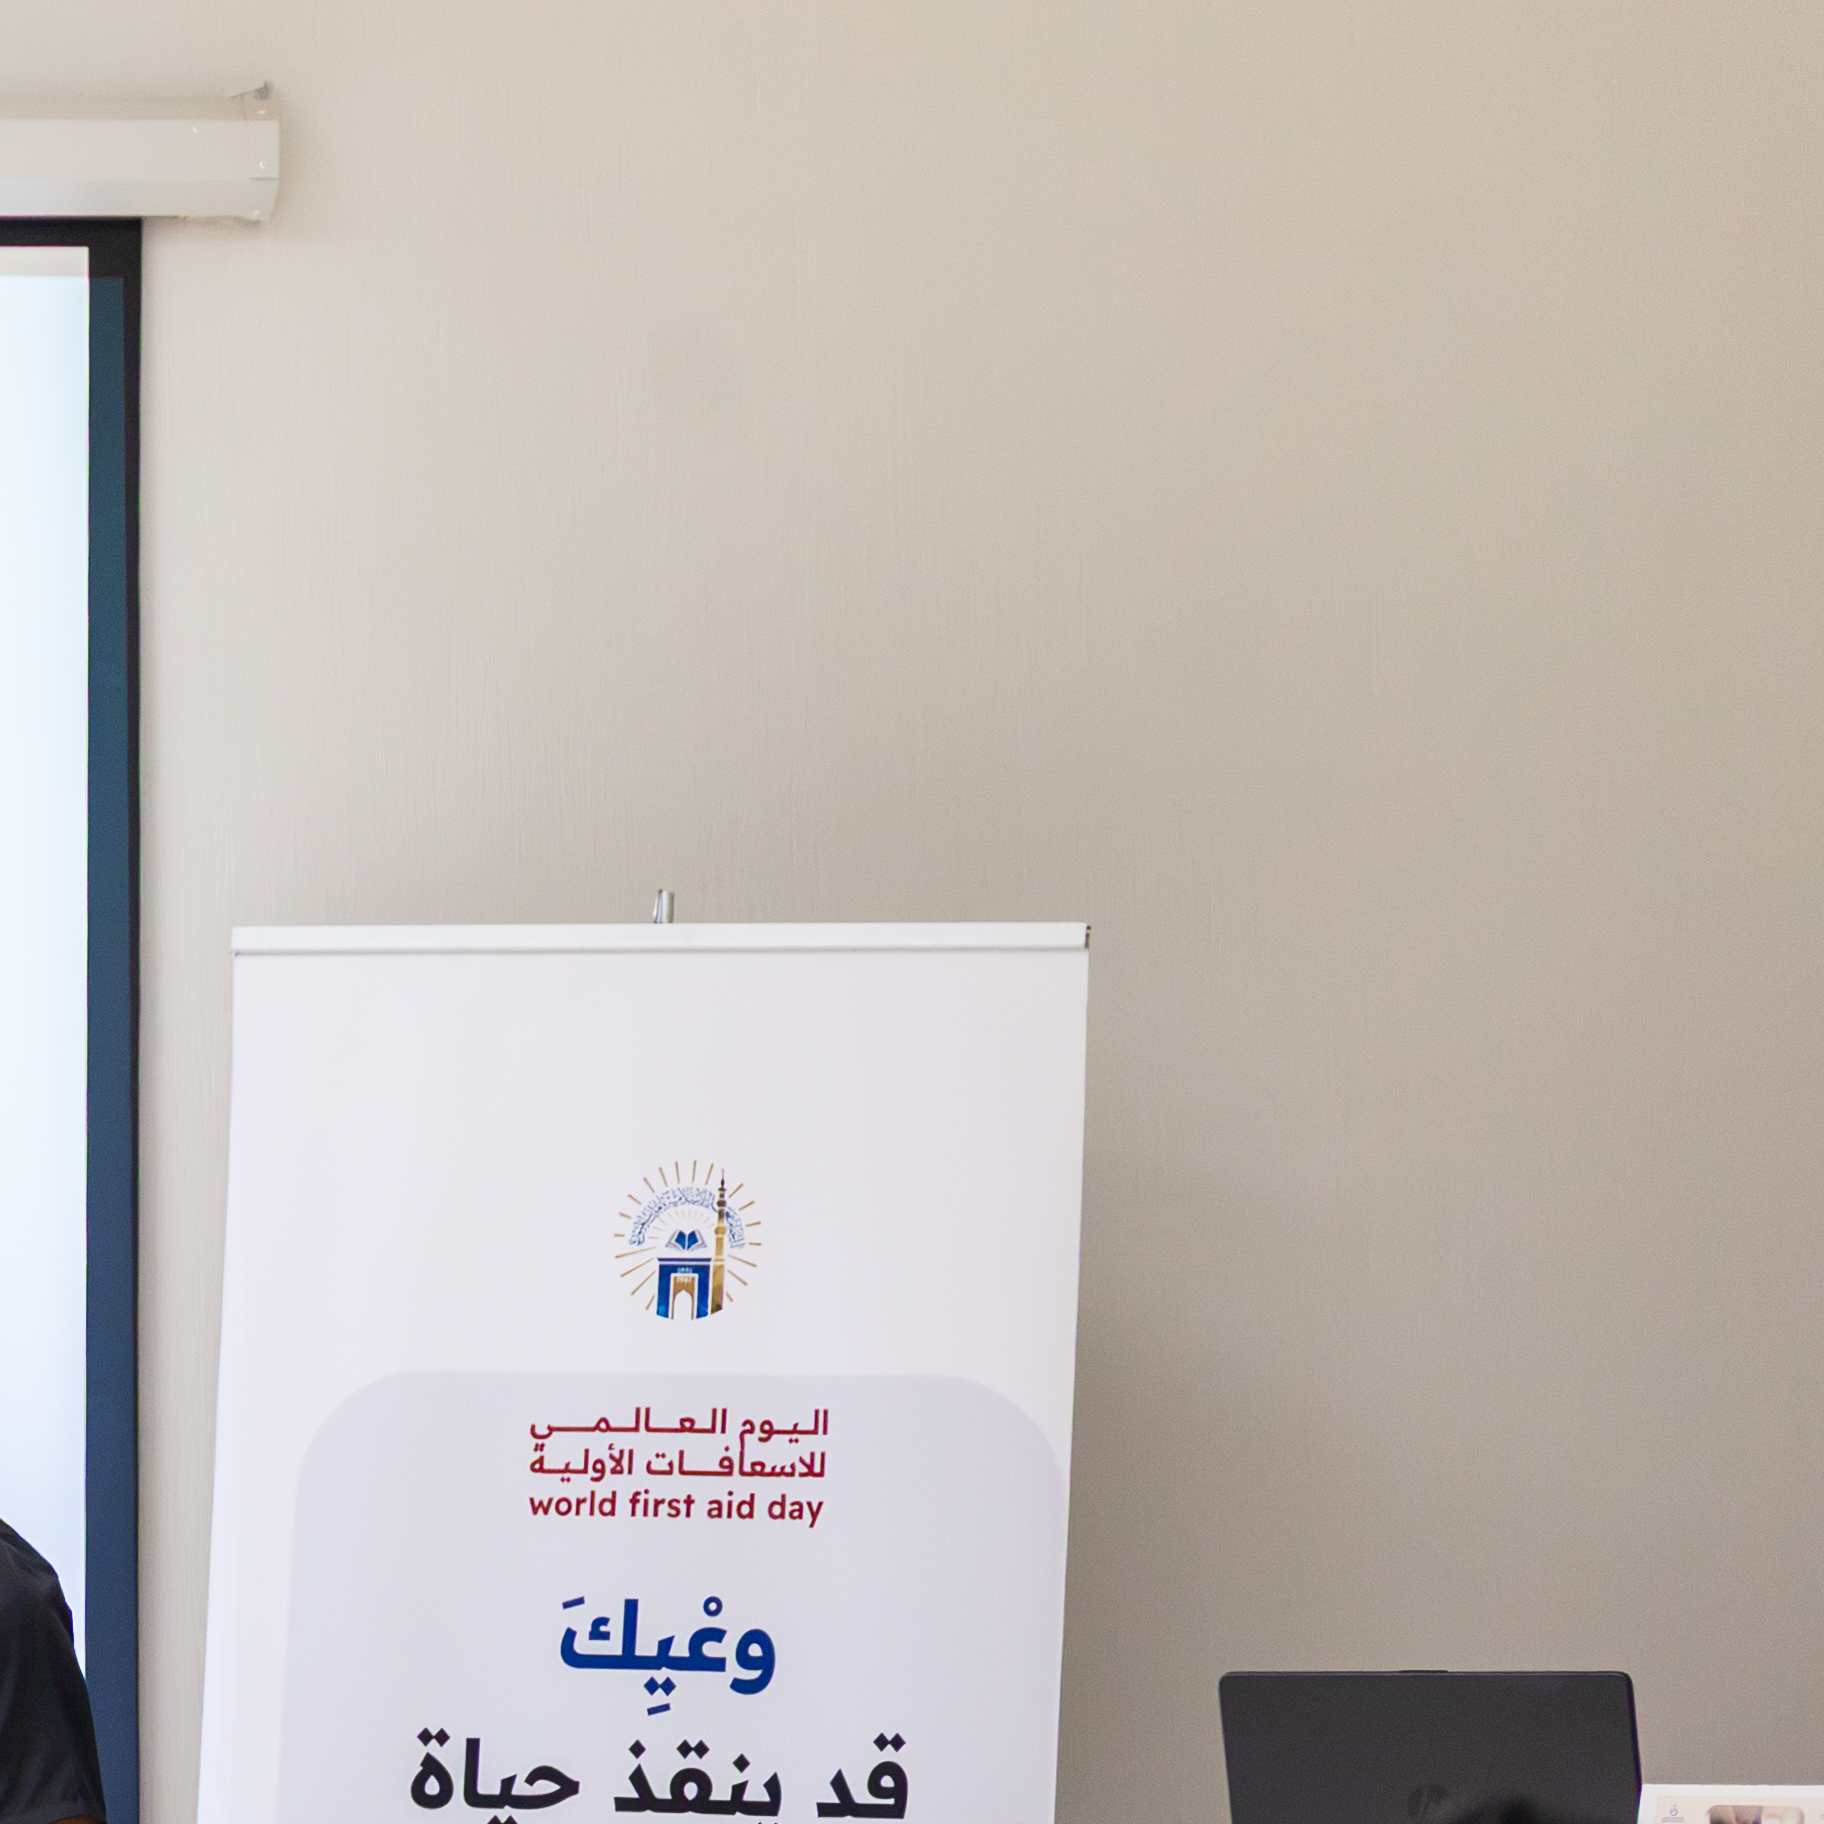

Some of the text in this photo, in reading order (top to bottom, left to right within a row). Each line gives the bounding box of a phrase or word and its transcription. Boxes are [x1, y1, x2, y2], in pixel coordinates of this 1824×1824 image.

[530, 1407, 828, 1453] اليوم العالمي
[530, 1443, 633, 1482] الأولية
[529, 1488, 823, 1528] world first aid day
[816, 1733, 908, 1819] قد
